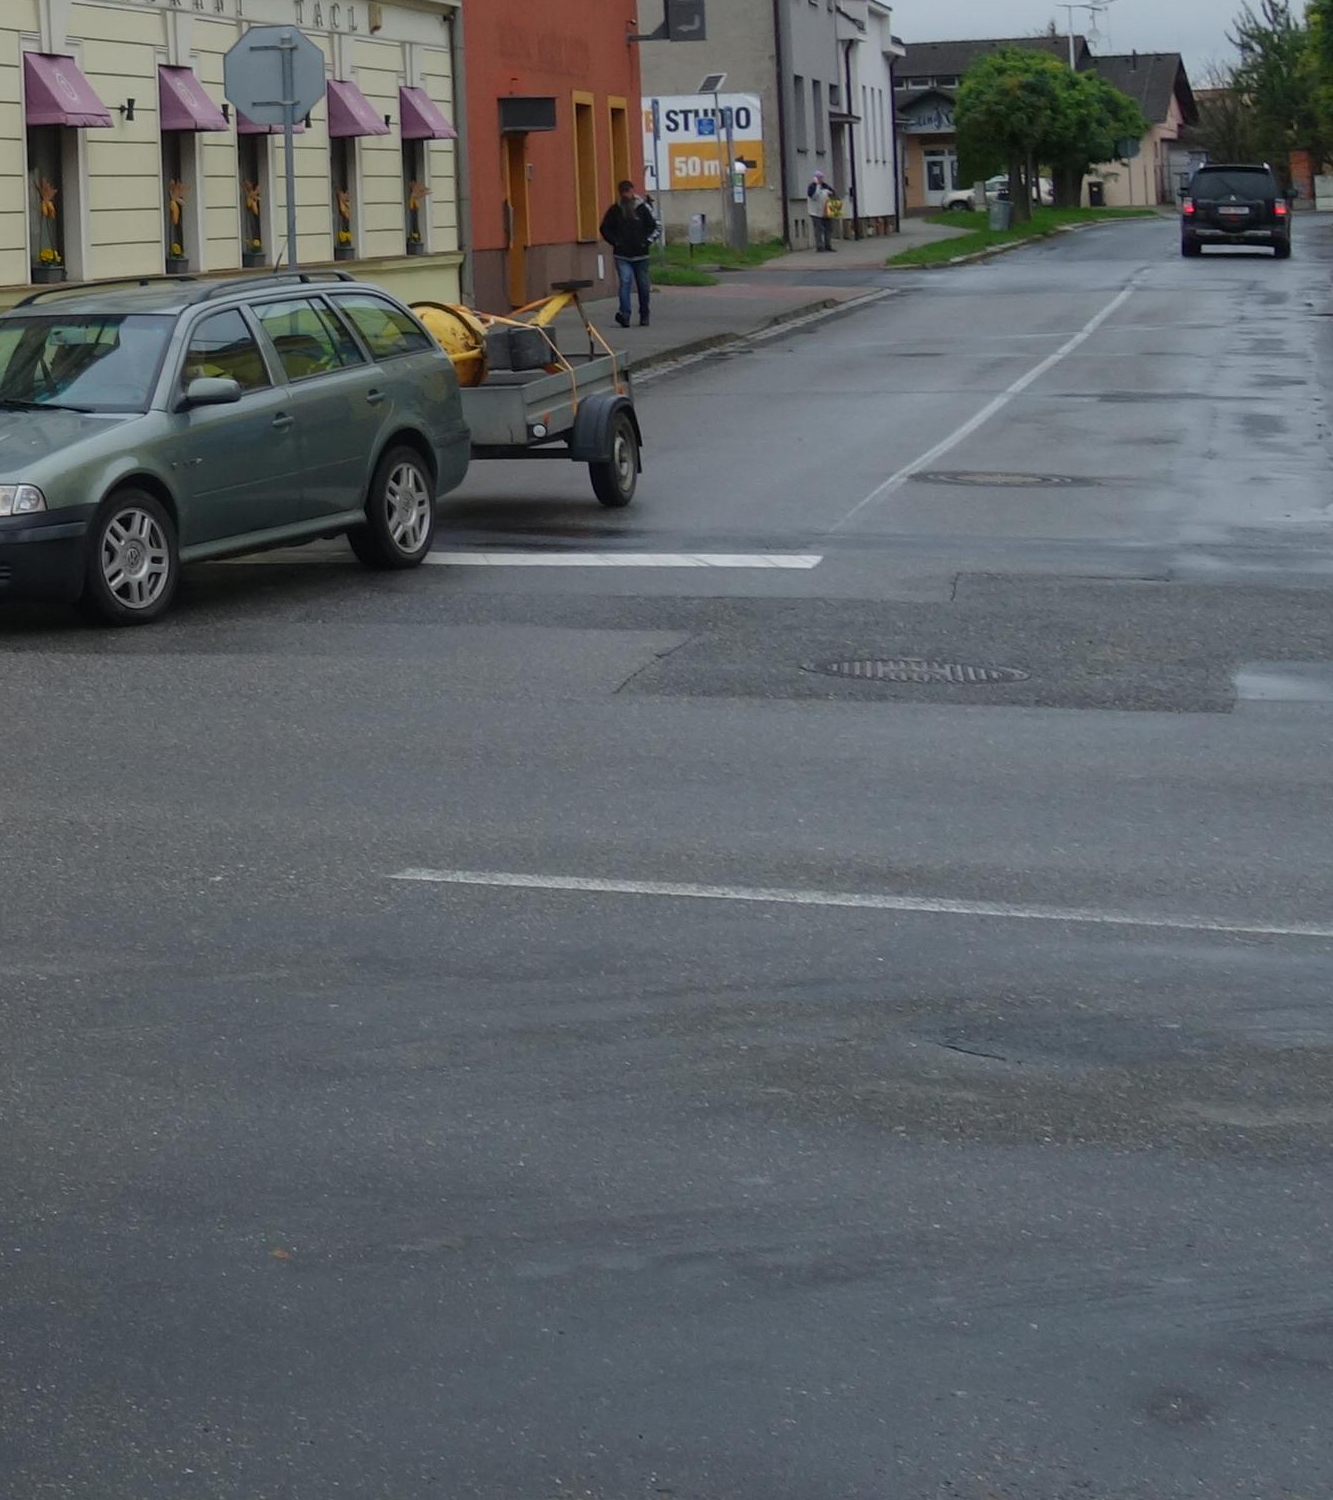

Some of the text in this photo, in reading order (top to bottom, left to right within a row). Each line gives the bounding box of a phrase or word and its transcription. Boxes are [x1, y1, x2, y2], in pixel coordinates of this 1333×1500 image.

[665, 107, 751, 132] STDO
[674, 156, 701, 177] 50
[703, 158, 721, 177] m
